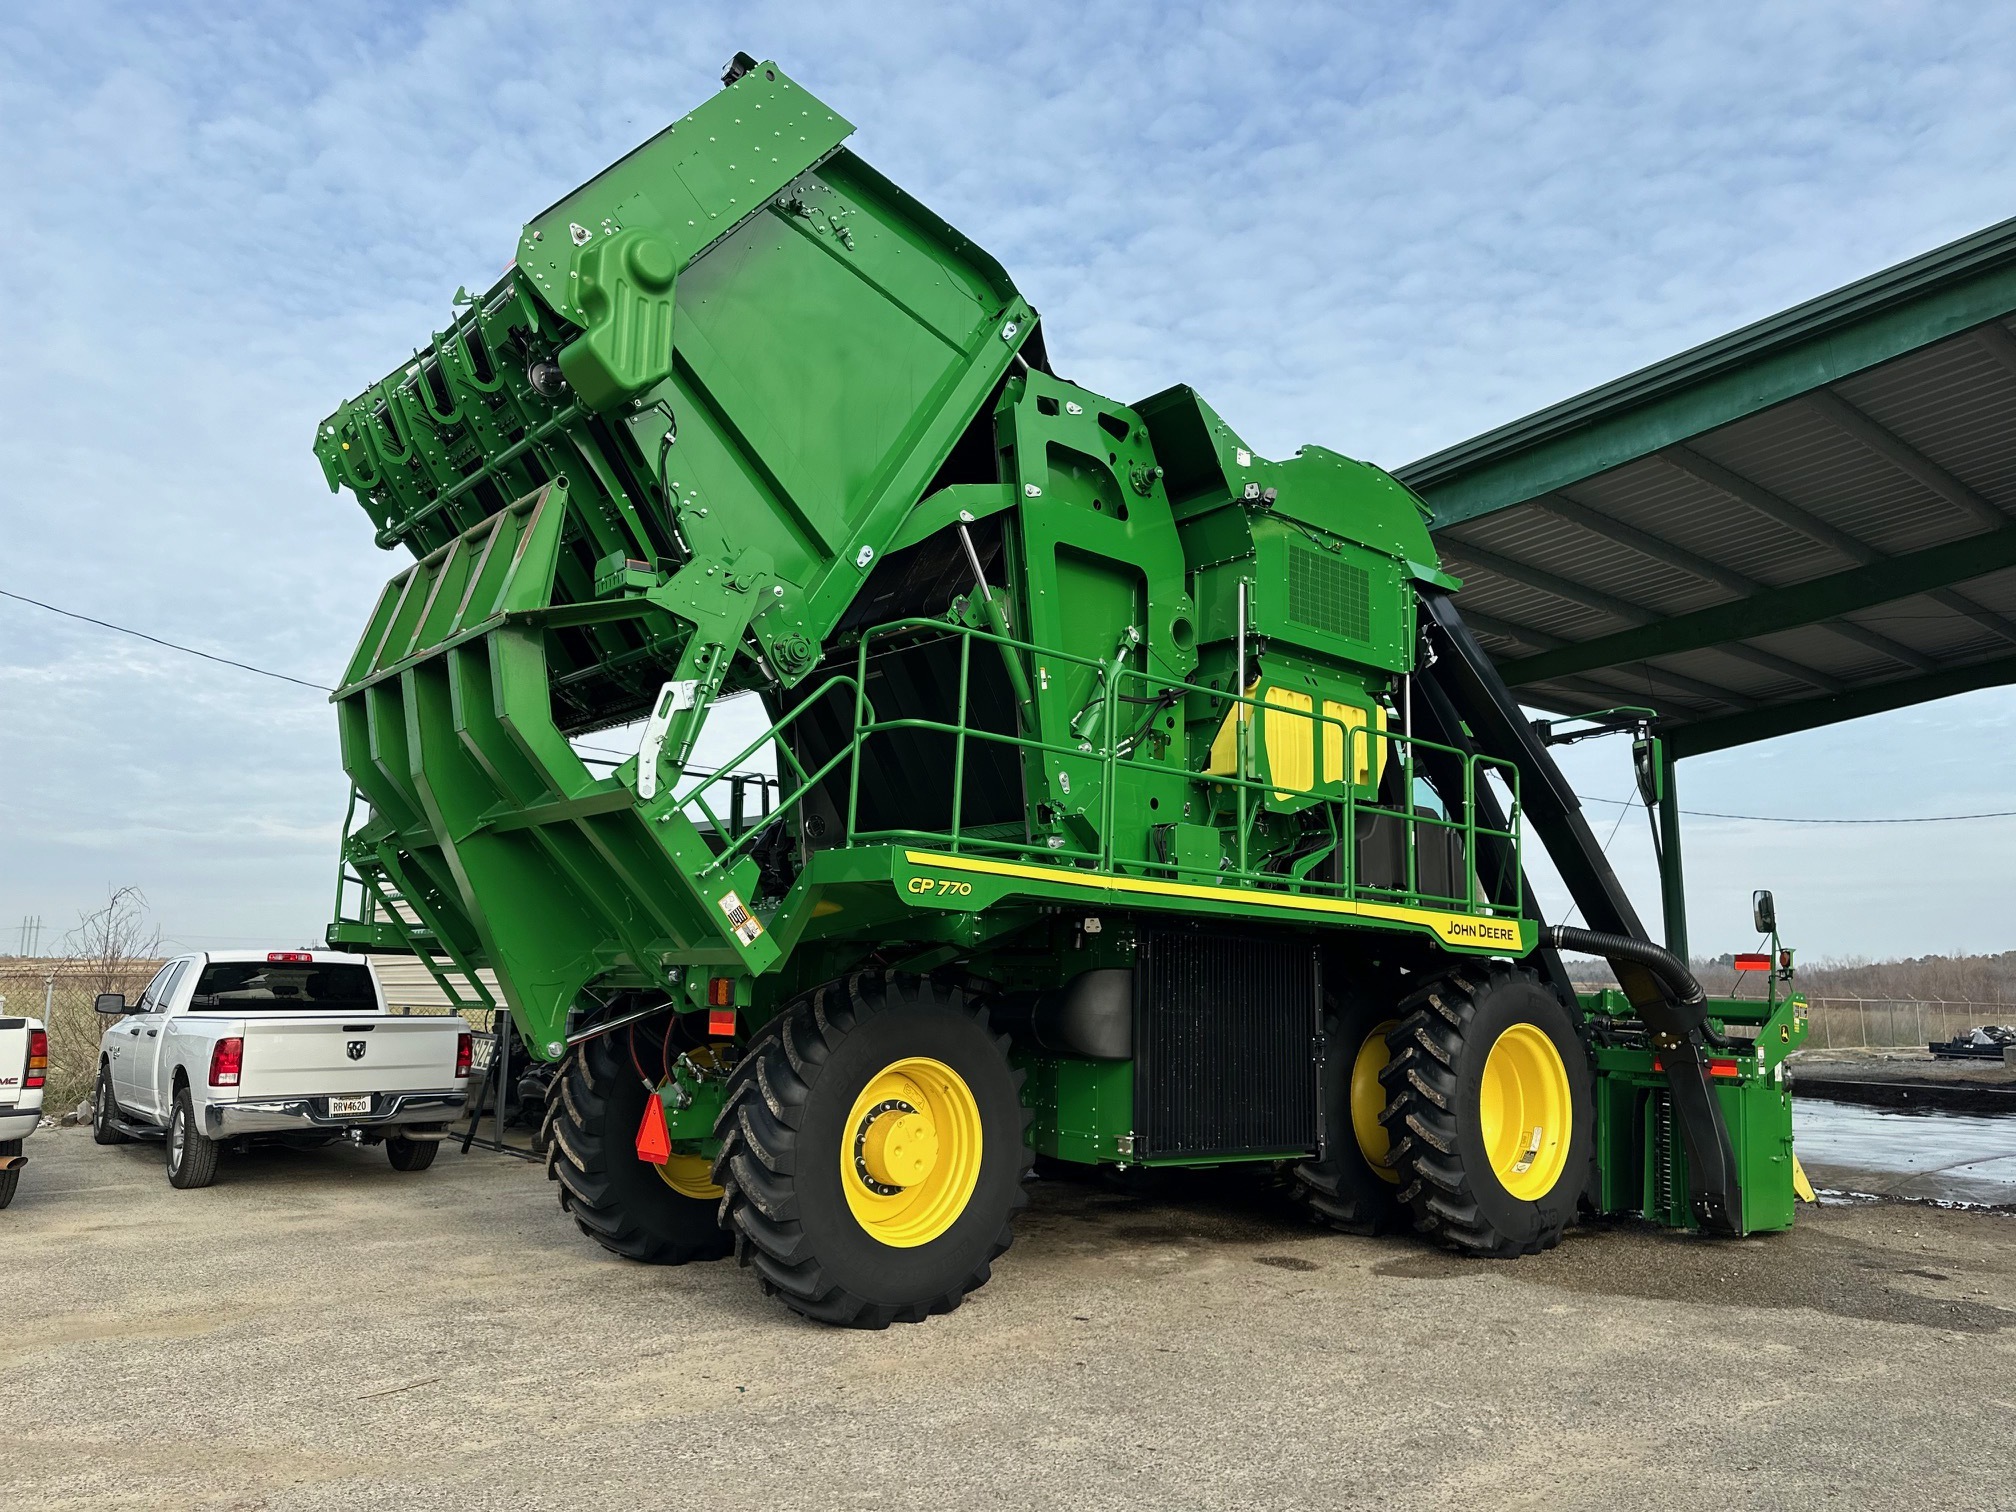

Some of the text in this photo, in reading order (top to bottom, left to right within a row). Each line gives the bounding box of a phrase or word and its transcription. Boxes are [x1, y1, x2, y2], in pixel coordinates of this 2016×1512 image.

[907, 877, 972, 896] CP 770
[1447, 920, 1514, 941] JOHN DEERE
[0, 1077, 18, 1085] MC
